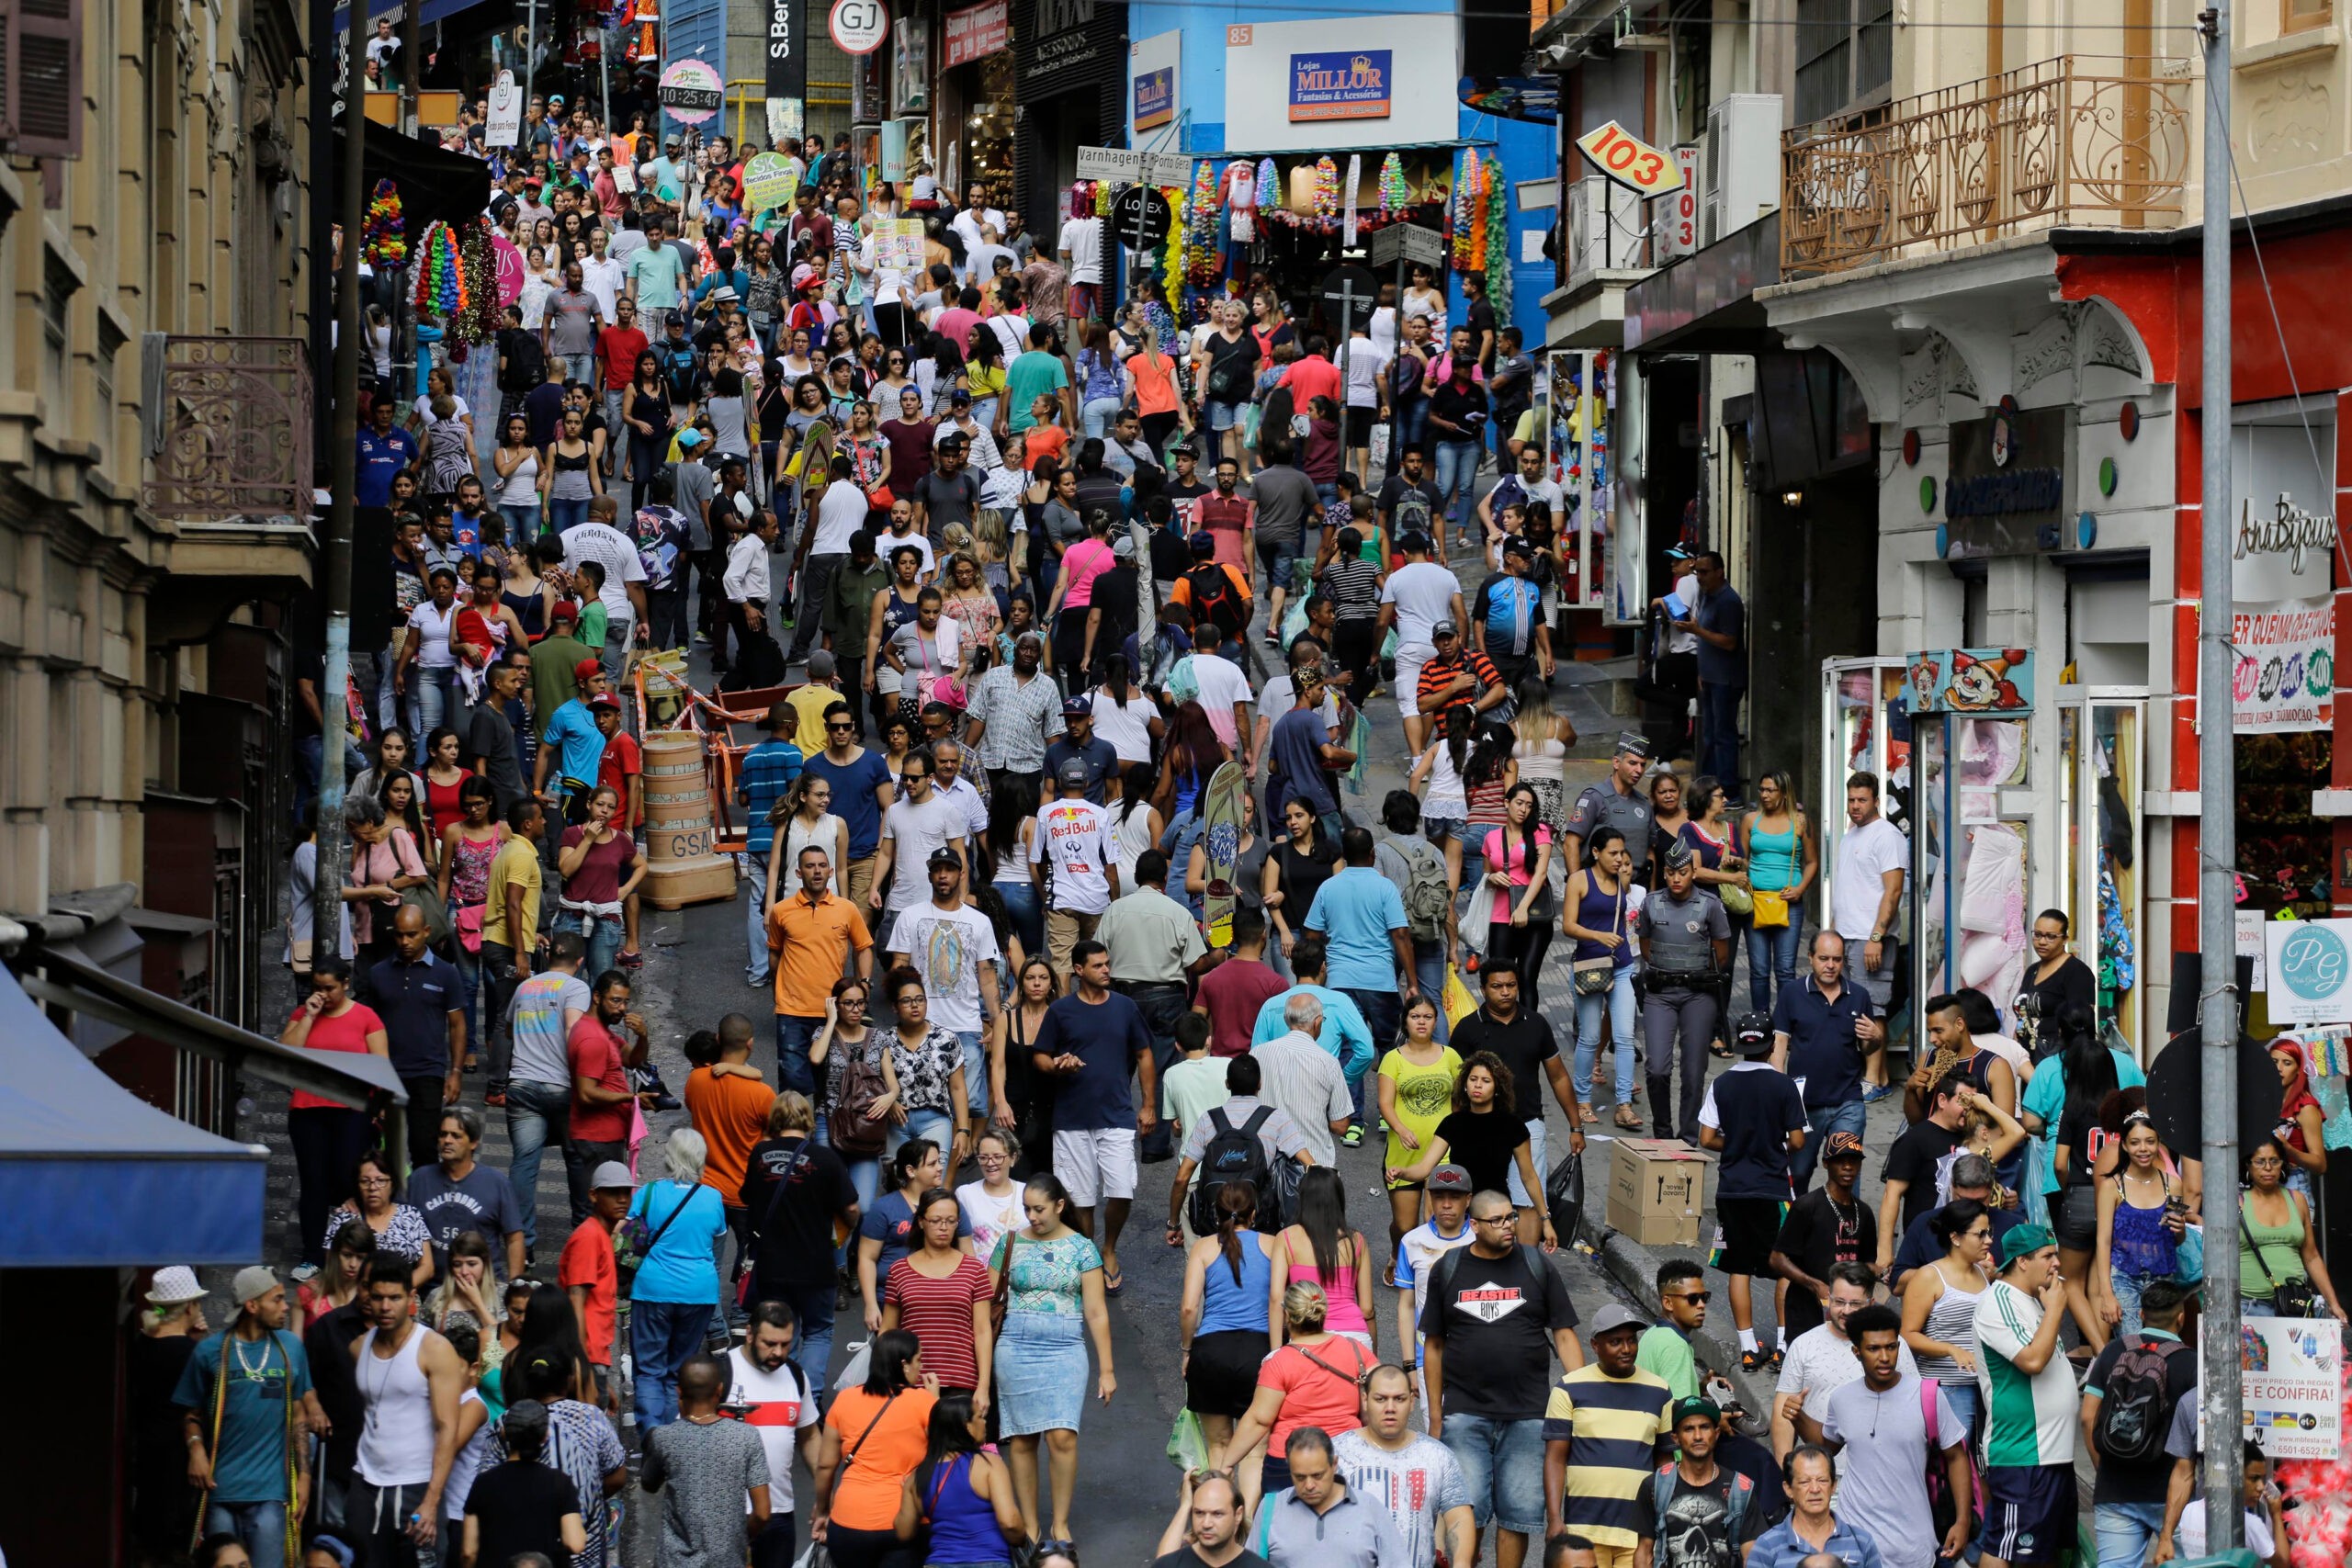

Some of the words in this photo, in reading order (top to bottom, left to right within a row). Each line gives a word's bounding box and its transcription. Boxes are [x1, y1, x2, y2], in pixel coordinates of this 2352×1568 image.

[840, 3, 877, 30] GJ
[1230, 28, 1250, 44] 85
[1297, 62, 1320, 71] Lojas
[1296, 68, 1383, 91] MILLOR
[662, 87, 719, 107] 10:25:47
[1297, 92, 1332, 102] Fantasias
[1334, 92, 1341, 100] &
[1343, 89, 1382, 99] Acessórios
[752, 154, 780, 174] SK
[1080, 149, 1139, 167] Varnhagen
[1155, 154, 1174, 168] Porto
[1175, 158, 1192, 171] Geral
[1590, 126, 1664, 186] 103
[745, 175, 772, 184] Tecidos
[1125, 198, 1162, 214] LOEX
[1679, 166, 1694, 245] 103
[1408, 228, 1442, 249] Varnhagen
[2252, 614, 2292, 645] QUEIMA
[1051, 822, 1071, 840] Red
[1073, 819, 1096, 837] Bull
[672, 831, 709, 858] GSA
[1067, 864, 1089, 873] TOTAL
[2237, 931, 2260, 942] 20%
[425, 1192, 482, 1214] CALIFORNIA
[442, 1227, 459, 1239] 56
[1461, 1289, 1519, 1302] BEASTIE
[1481, 1302, 1499, 1319] BOYS
[2255, 1386, 2262, 1398] E
[2267, 1387, 2334, 1402] CONFIRA!
[2278, 1436, 2332, 1444] www.mbfesta.net
[2278, 1445, 2321, 1455] 6501-6522
